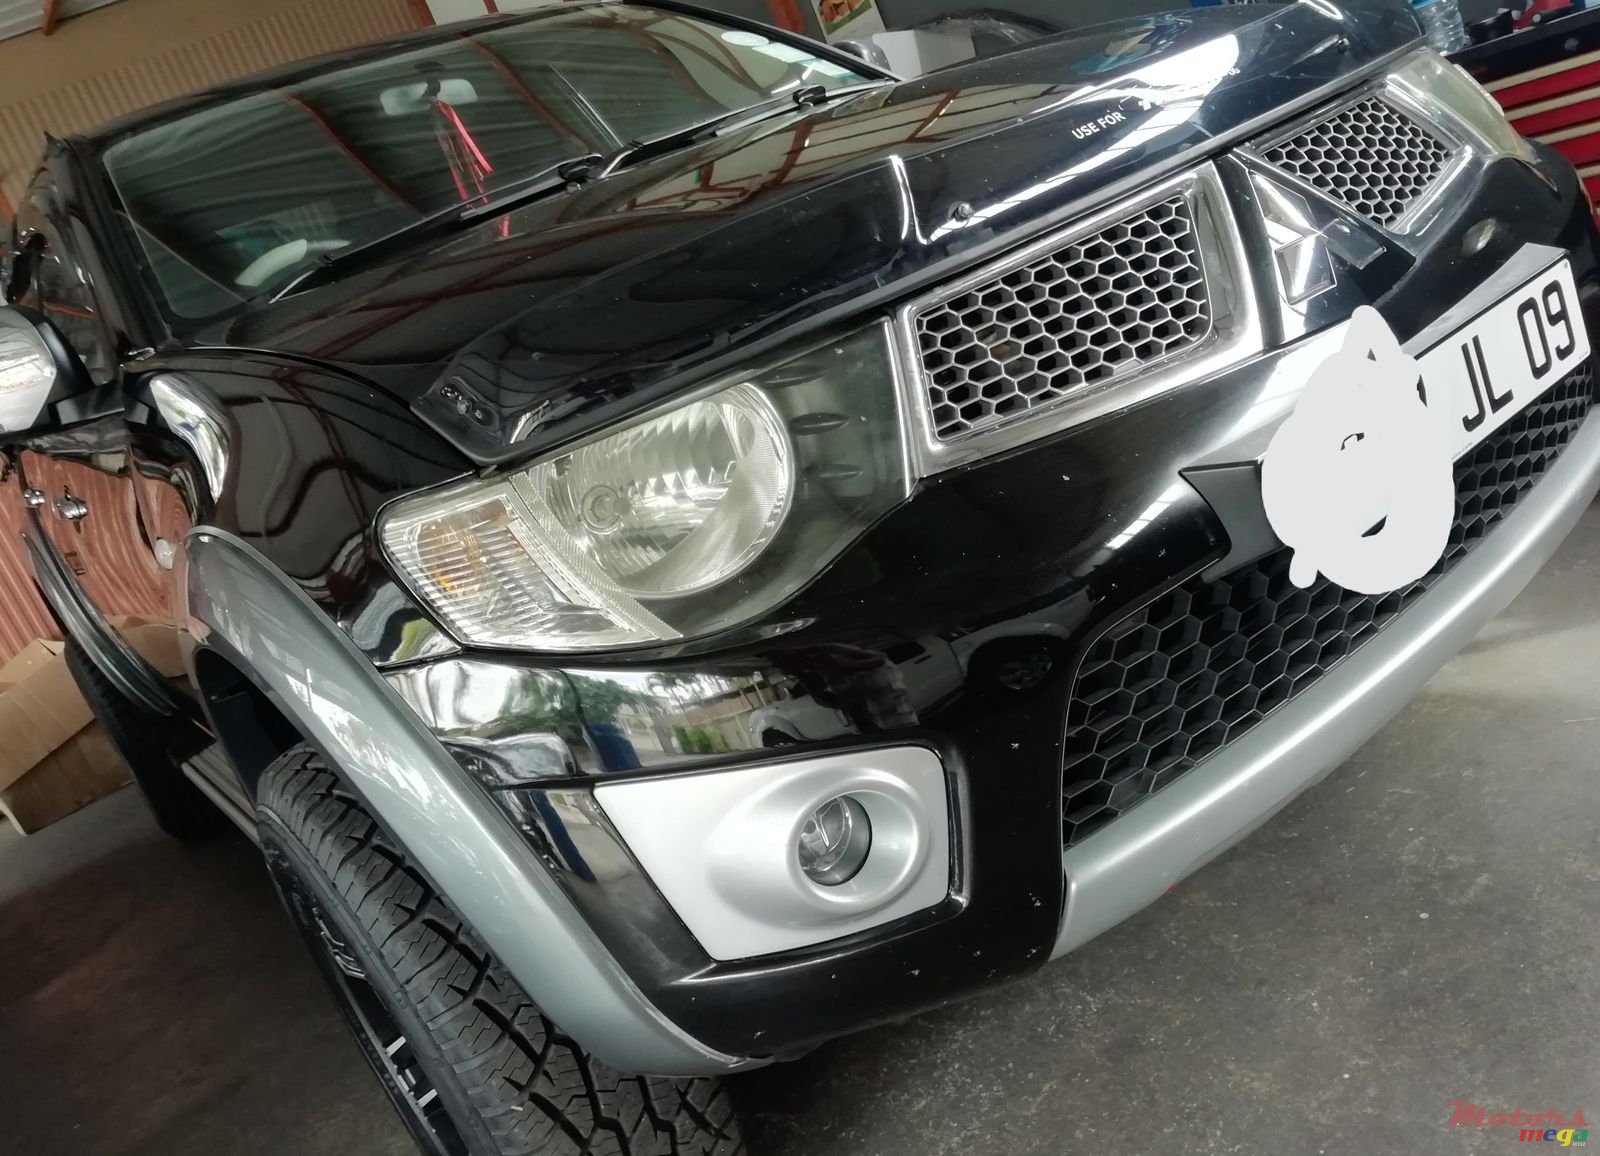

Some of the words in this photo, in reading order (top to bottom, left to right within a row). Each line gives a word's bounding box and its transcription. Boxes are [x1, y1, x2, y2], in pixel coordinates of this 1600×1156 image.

[1071, 121, 1100, 140] USE
[1096, 110, 1127, 129] FOR
[1461, 334, 1514, 433] JL
[1517, 280, 1576, 380] 09
